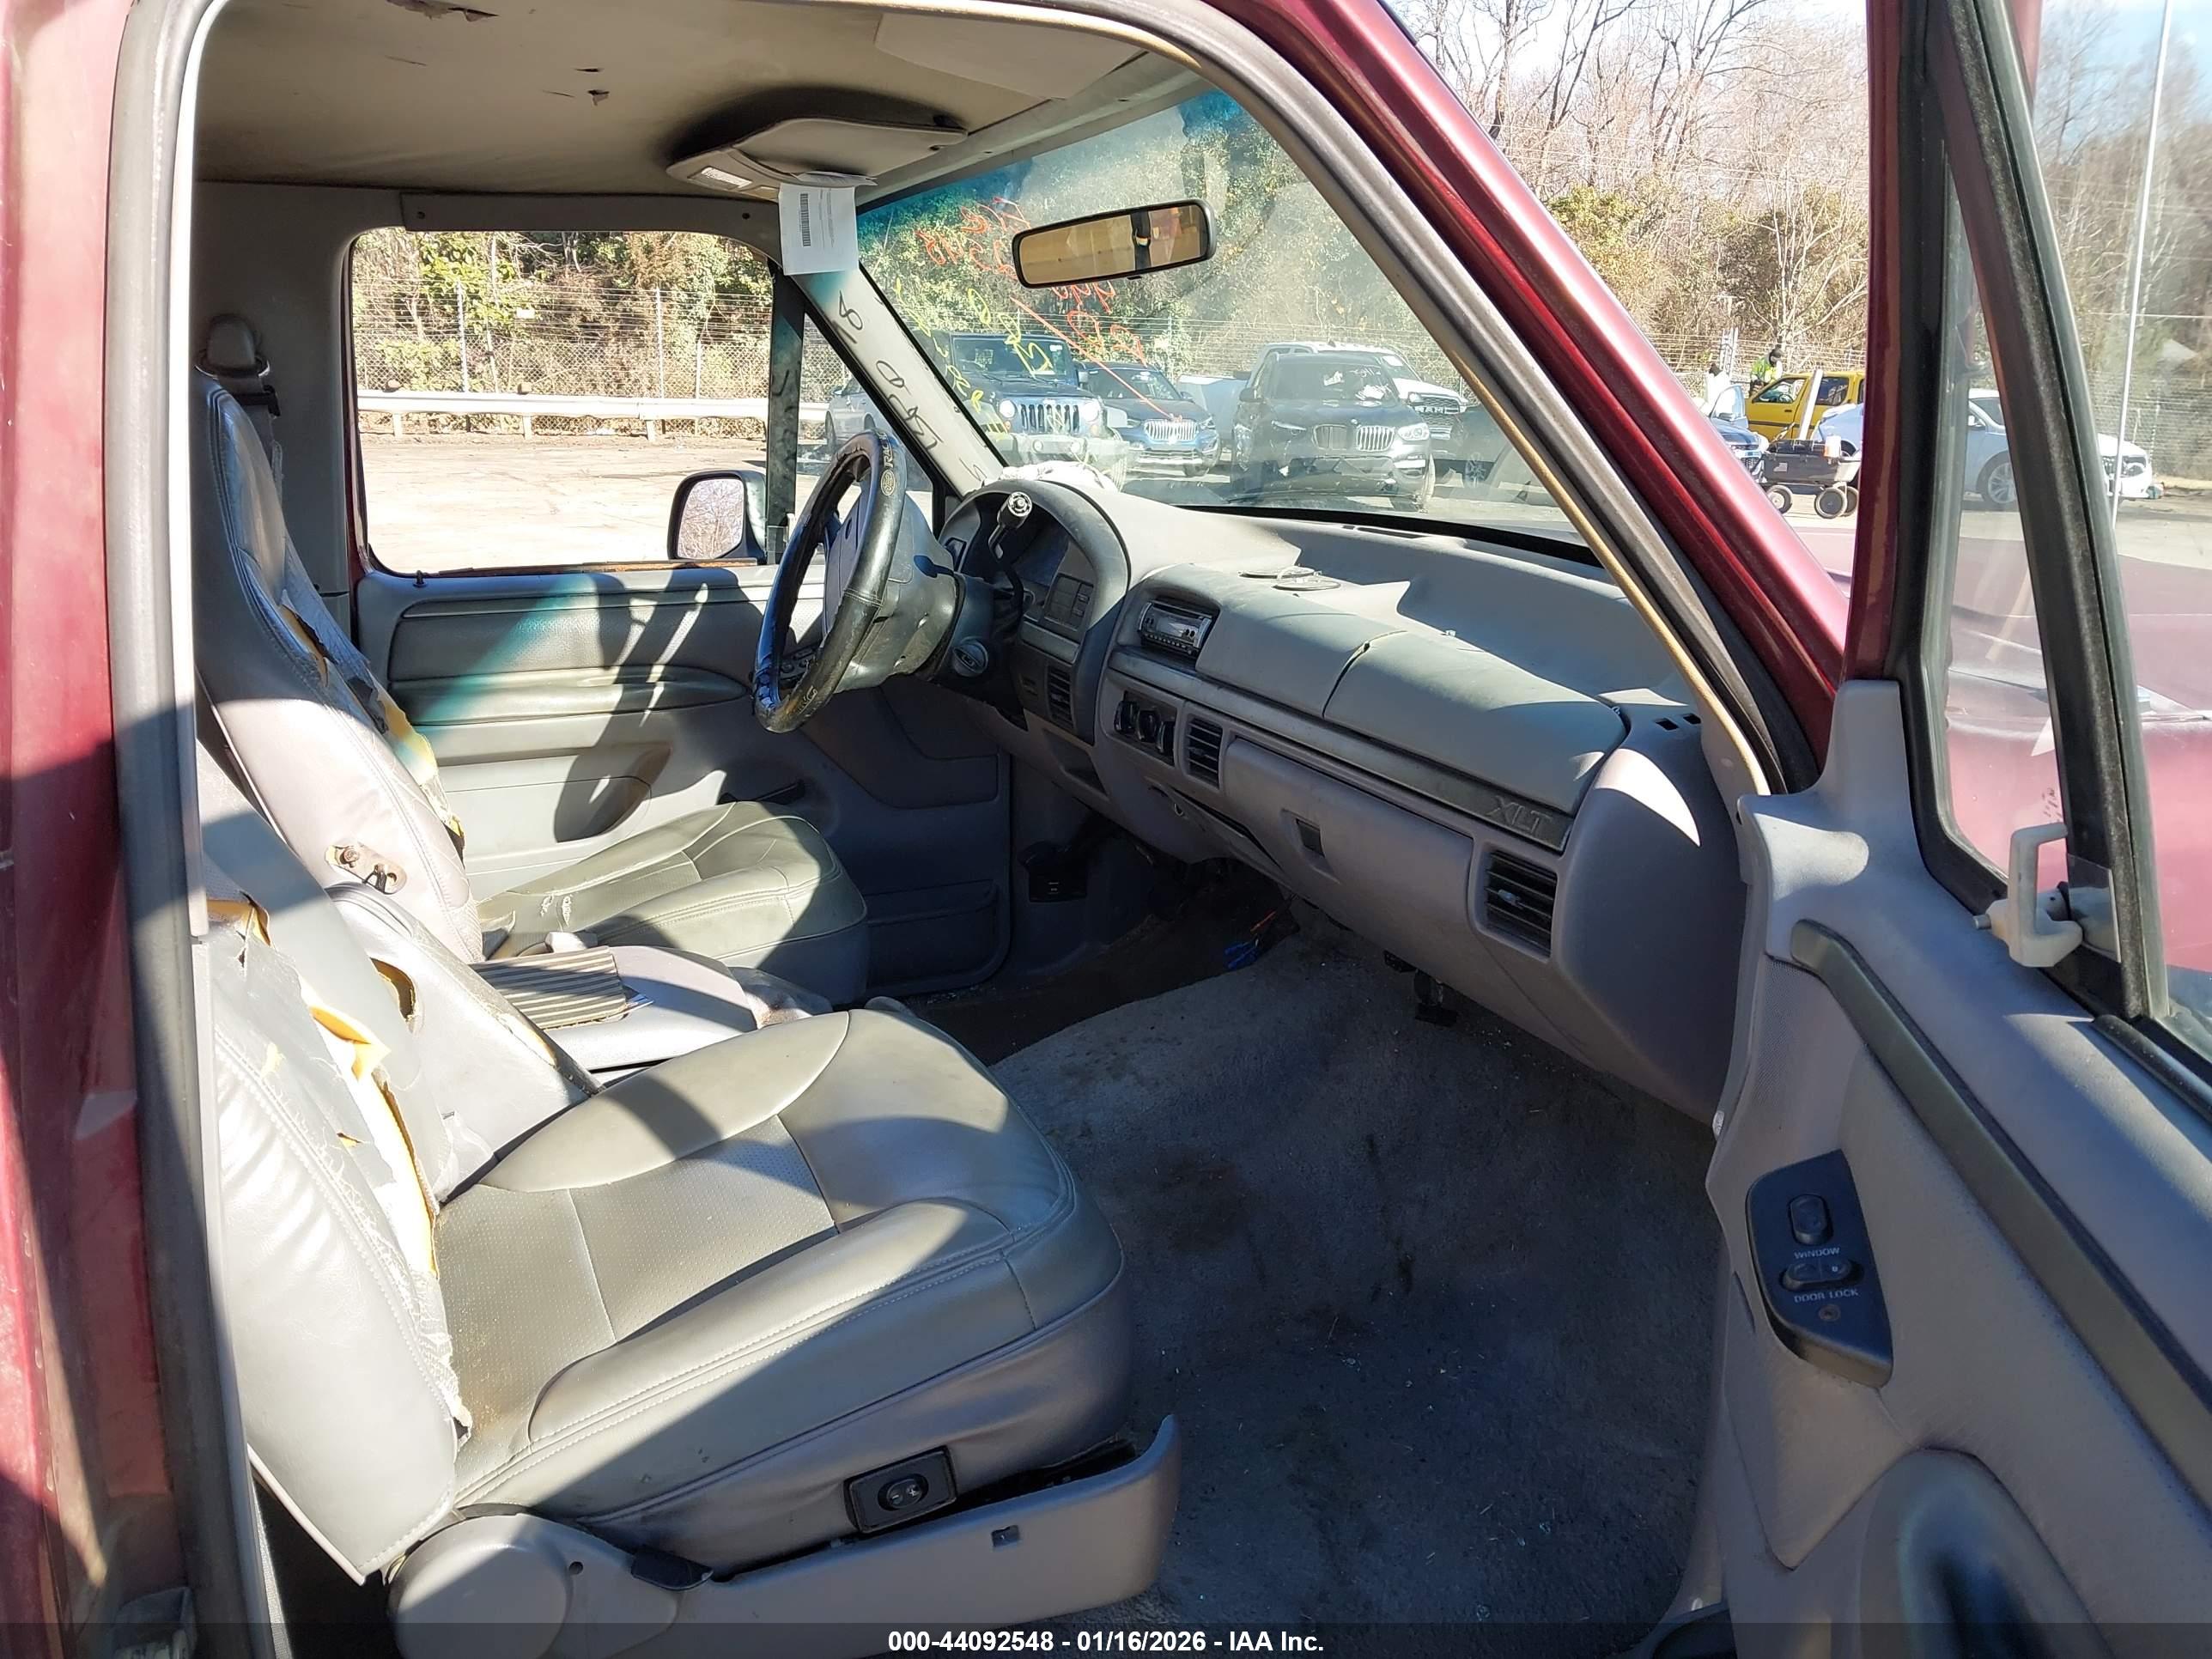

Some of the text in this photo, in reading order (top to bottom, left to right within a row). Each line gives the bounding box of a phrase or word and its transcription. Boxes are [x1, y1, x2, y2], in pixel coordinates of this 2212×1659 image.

[1486, 795, 1553, 836] XLT
[1793, 1247, 1840, 1260] WINDOW
[1794, 1288, 1859, 1304] DOOR LOCK
